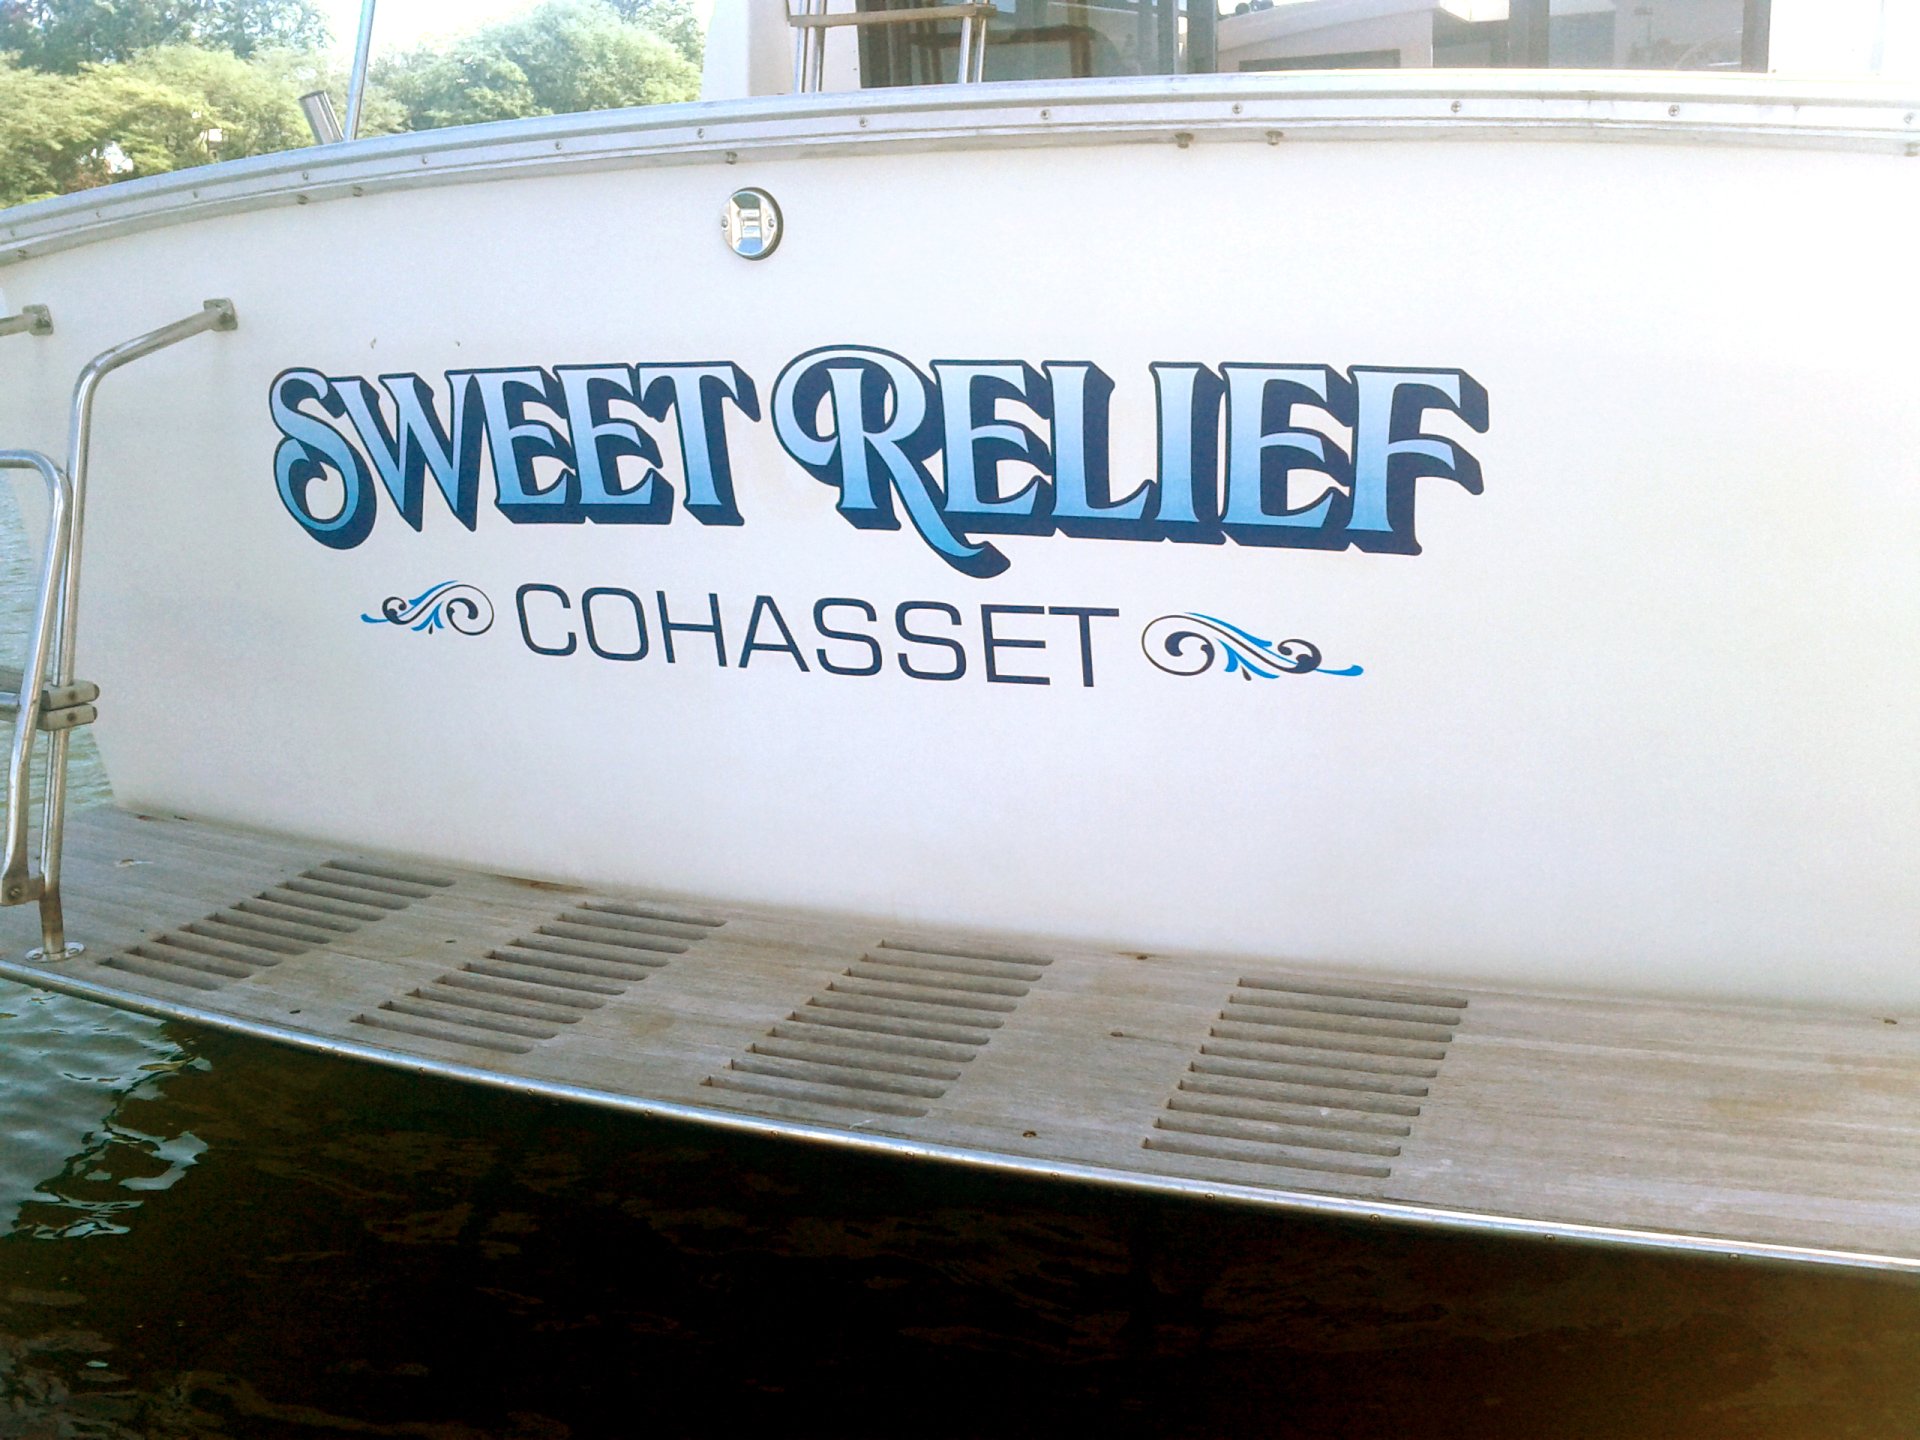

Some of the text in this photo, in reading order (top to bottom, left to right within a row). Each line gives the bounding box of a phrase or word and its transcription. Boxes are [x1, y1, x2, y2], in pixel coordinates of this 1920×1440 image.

[269, 344, 1489, 579] SWEET RELIEF
[515, 583, 1120, 688] COHASSET
